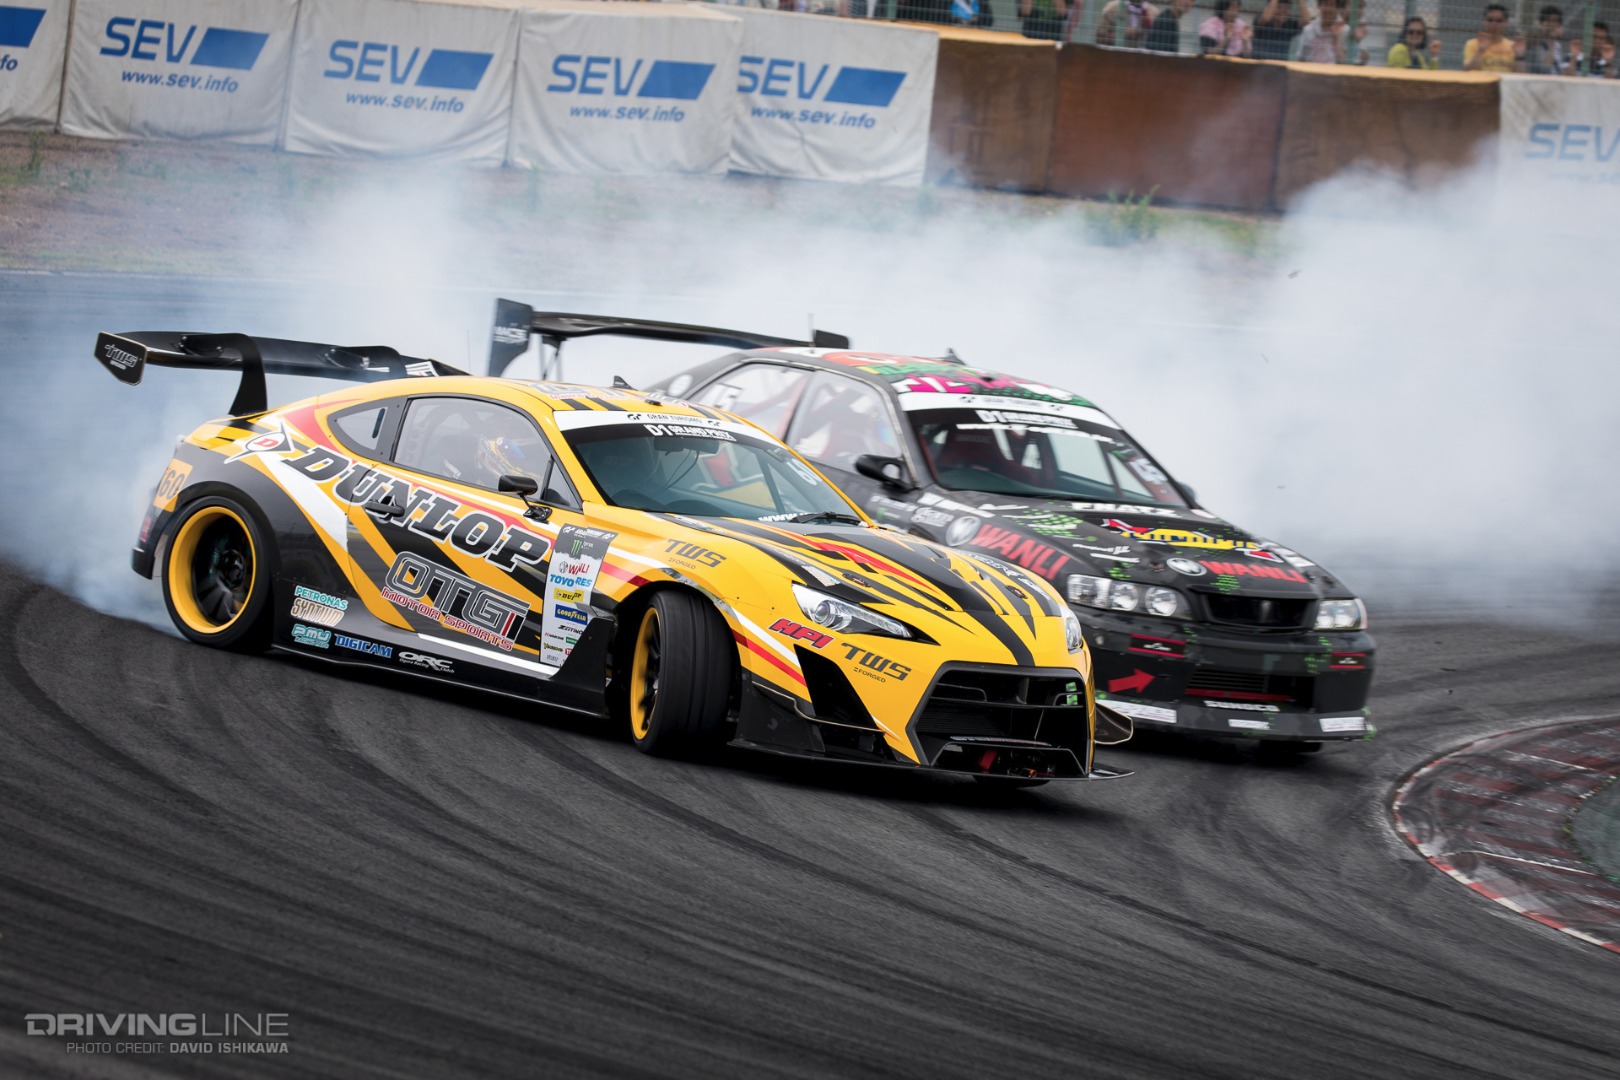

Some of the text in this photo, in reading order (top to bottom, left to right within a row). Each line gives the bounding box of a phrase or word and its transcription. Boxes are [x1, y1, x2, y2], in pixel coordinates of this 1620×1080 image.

[100, 16, 197, 64] SEV
[324, 39, 421, 85] SEV
[547, 54, 643, 97] SEV
[738, 55, 829, 99] SEV
[121, 68, 239, 93] www.sev.info
[346, 90, 464, 113] www.sev.info
[569, 104, 685, 122] www.sev.info
[751, 105, 876, 129] www.sev.info
[1524, 123, 1620, 162] SEV
[159, 469, 186, 501] 60
[281, 444, 552, 573] DUNLOP
[665, 538, 727, 568] TWS
[969, 523, 1071, 581] WANLI
[549, 573, 576, 588] TOYO
[1199, 559, 1308, 585] WANLI
[290, 596, 345, 628] SYNTIUM
[294, 584, 349, 611] PETRONAS
[381, 586, 515, 652] MOTOR SPORTS
[768, 617, 834, 650] HPI
[334, 633, 393, 659] DIGICAM
[398, 651, 453, 672] ORC
[841, 642, 912, 681] TWS
[858, 667, 887, 684] FORGED
